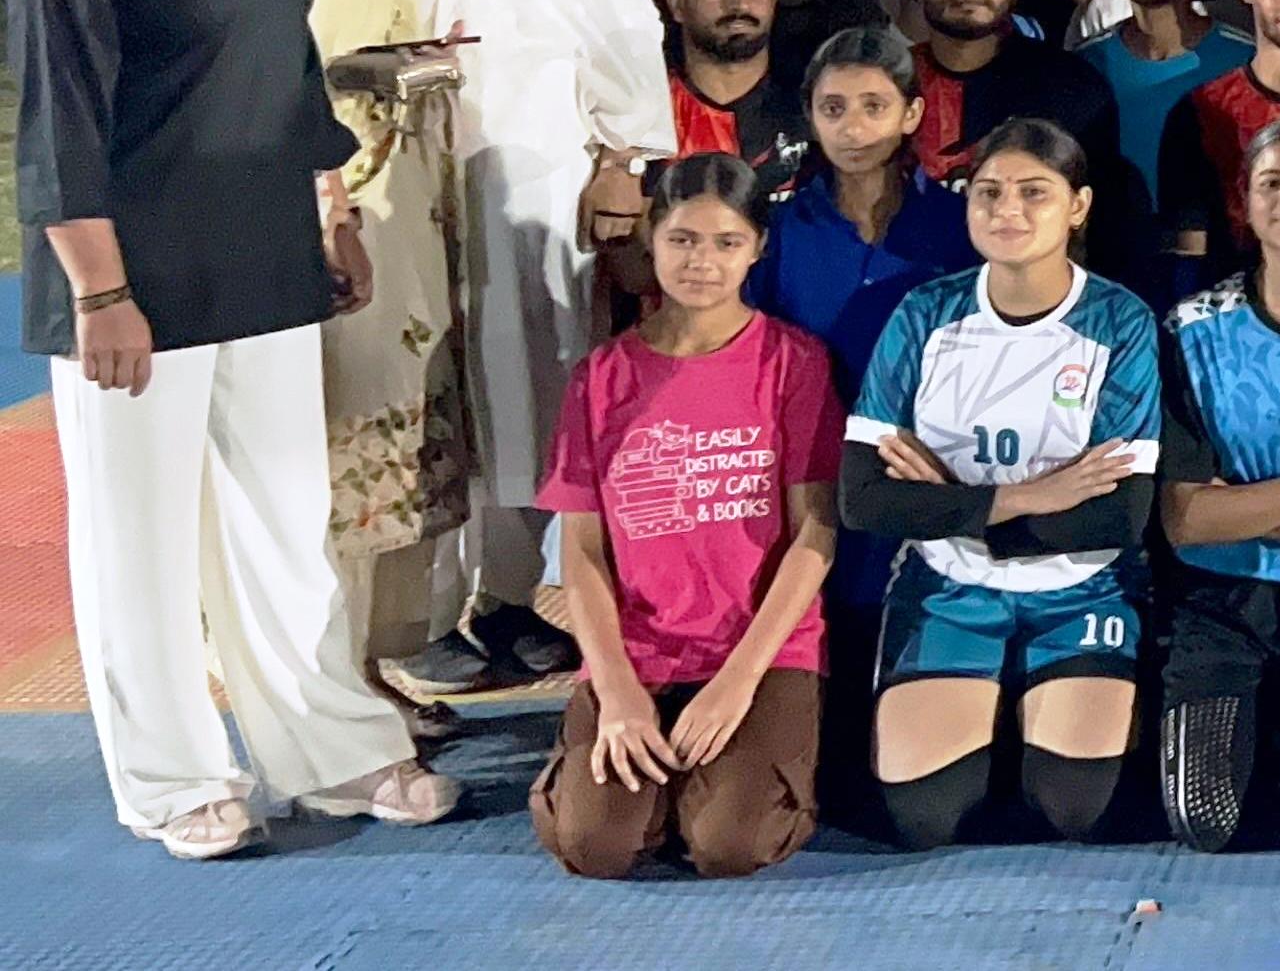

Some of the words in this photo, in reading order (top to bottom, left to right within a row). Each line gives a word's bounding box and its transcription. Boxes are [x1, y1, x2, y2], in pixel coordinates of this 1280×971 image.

[973, 425, 1021, 467] 10
[696, 479, 718, 499] BY
[725, 473, 772, 495] CATS
[697, 504, 710, 522] &
[713, 499, 771, 522] BOOKS
[1079, 613, 1125, 649] 10
